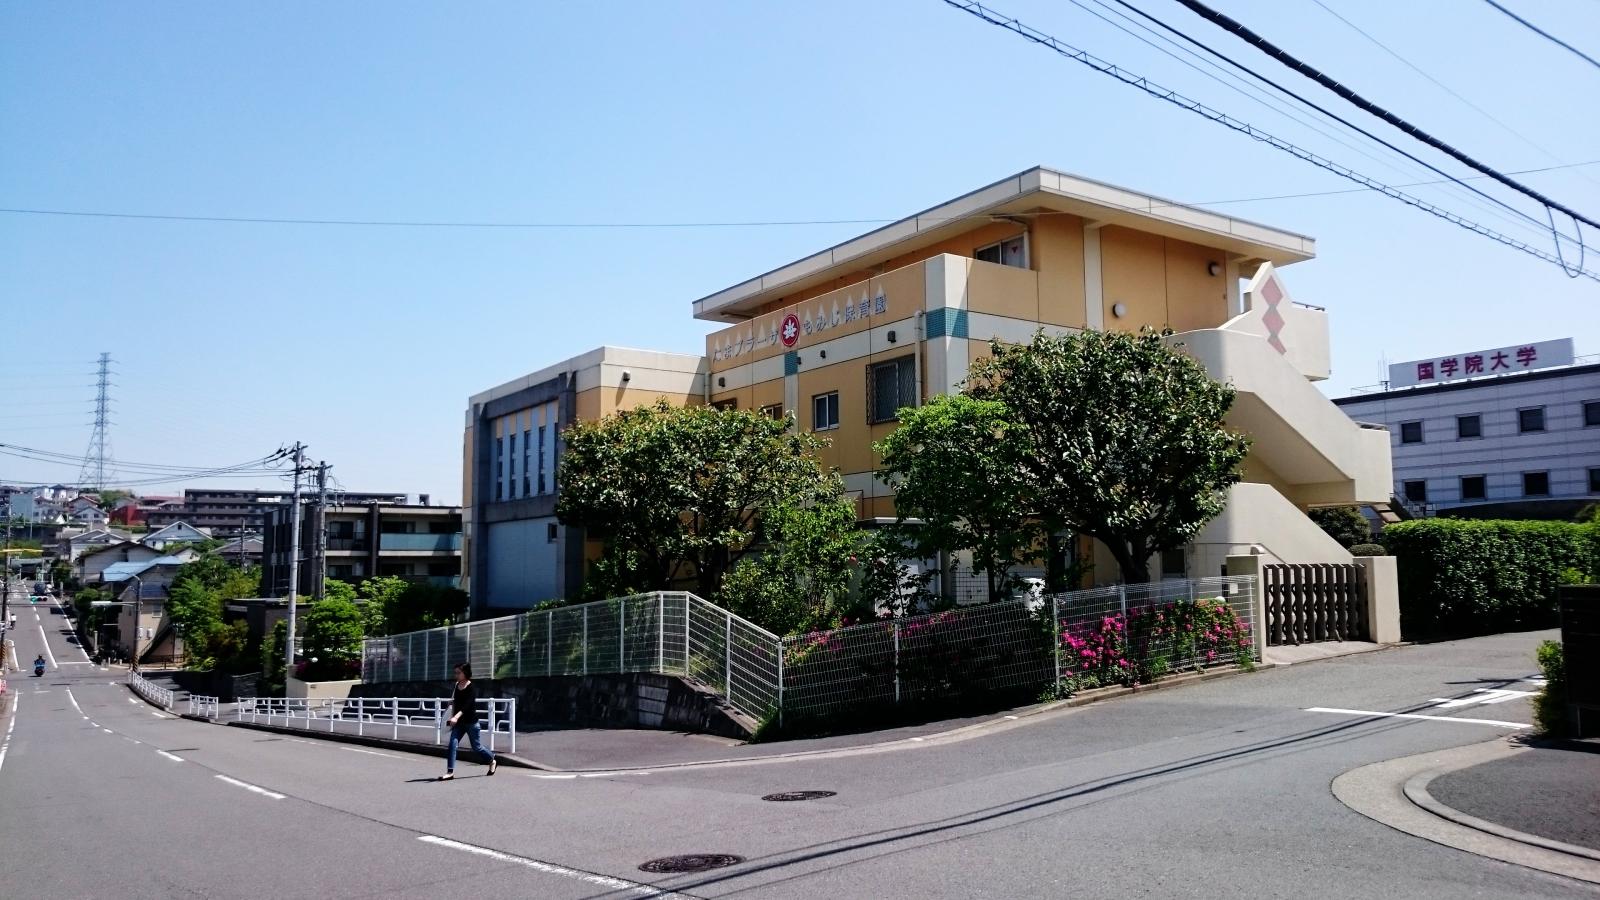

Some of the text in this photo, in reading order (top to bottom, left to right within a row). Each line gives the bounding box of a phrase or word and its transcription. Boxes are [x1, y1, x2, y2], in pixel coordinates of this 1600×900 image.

[803, 293, 887, 336] もみじ保育園
[1417, 346, 1538, 380] 国学院大学
